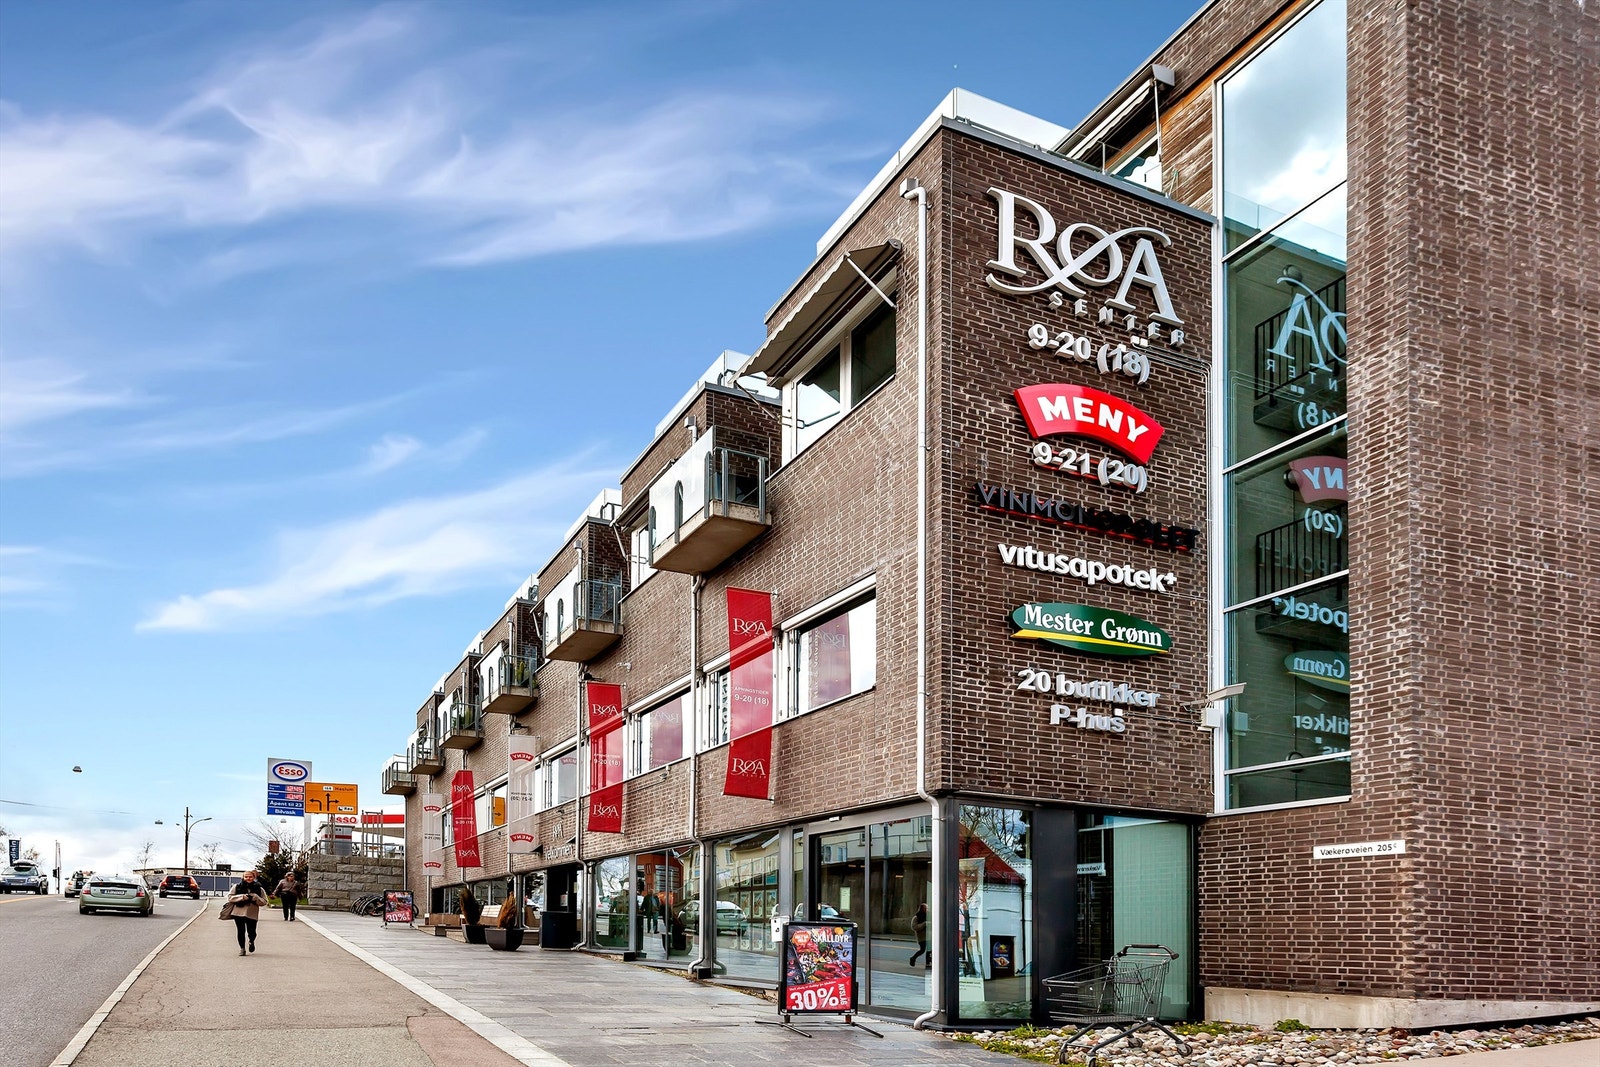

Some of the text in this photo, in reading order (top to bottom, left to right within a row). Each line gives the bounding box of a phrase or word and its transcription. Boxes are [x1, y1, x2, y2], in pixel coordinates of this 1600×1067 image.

[985, 186, 1184, 325] RØA
[1049, 290, 1185, 345] SENTER
[1028, 323, 1150, 384] 9-20 (18)
[1036, 395, 1149, 443] MENY
[1032, 441, 1148, 493] 9-21 (20)
[733, 617, 770, 639] RØA
[1023, 603, 1163, 647] Mester Grønn
[734, 693, 770, 706] 9-20 (18)
[1016, 668, 1160, 708] 20 butikker
[592, 703, 619, 716] RØA
[1049, 704, 1126, 733] P-hus
[278, 766, 303, 776] Esso
[731, 757, 765, 776] RØA
[593, 804, 619, 816] RØA
[387, 912, 407, 921] 30%
[790, 986, 839, 1010] 30%
